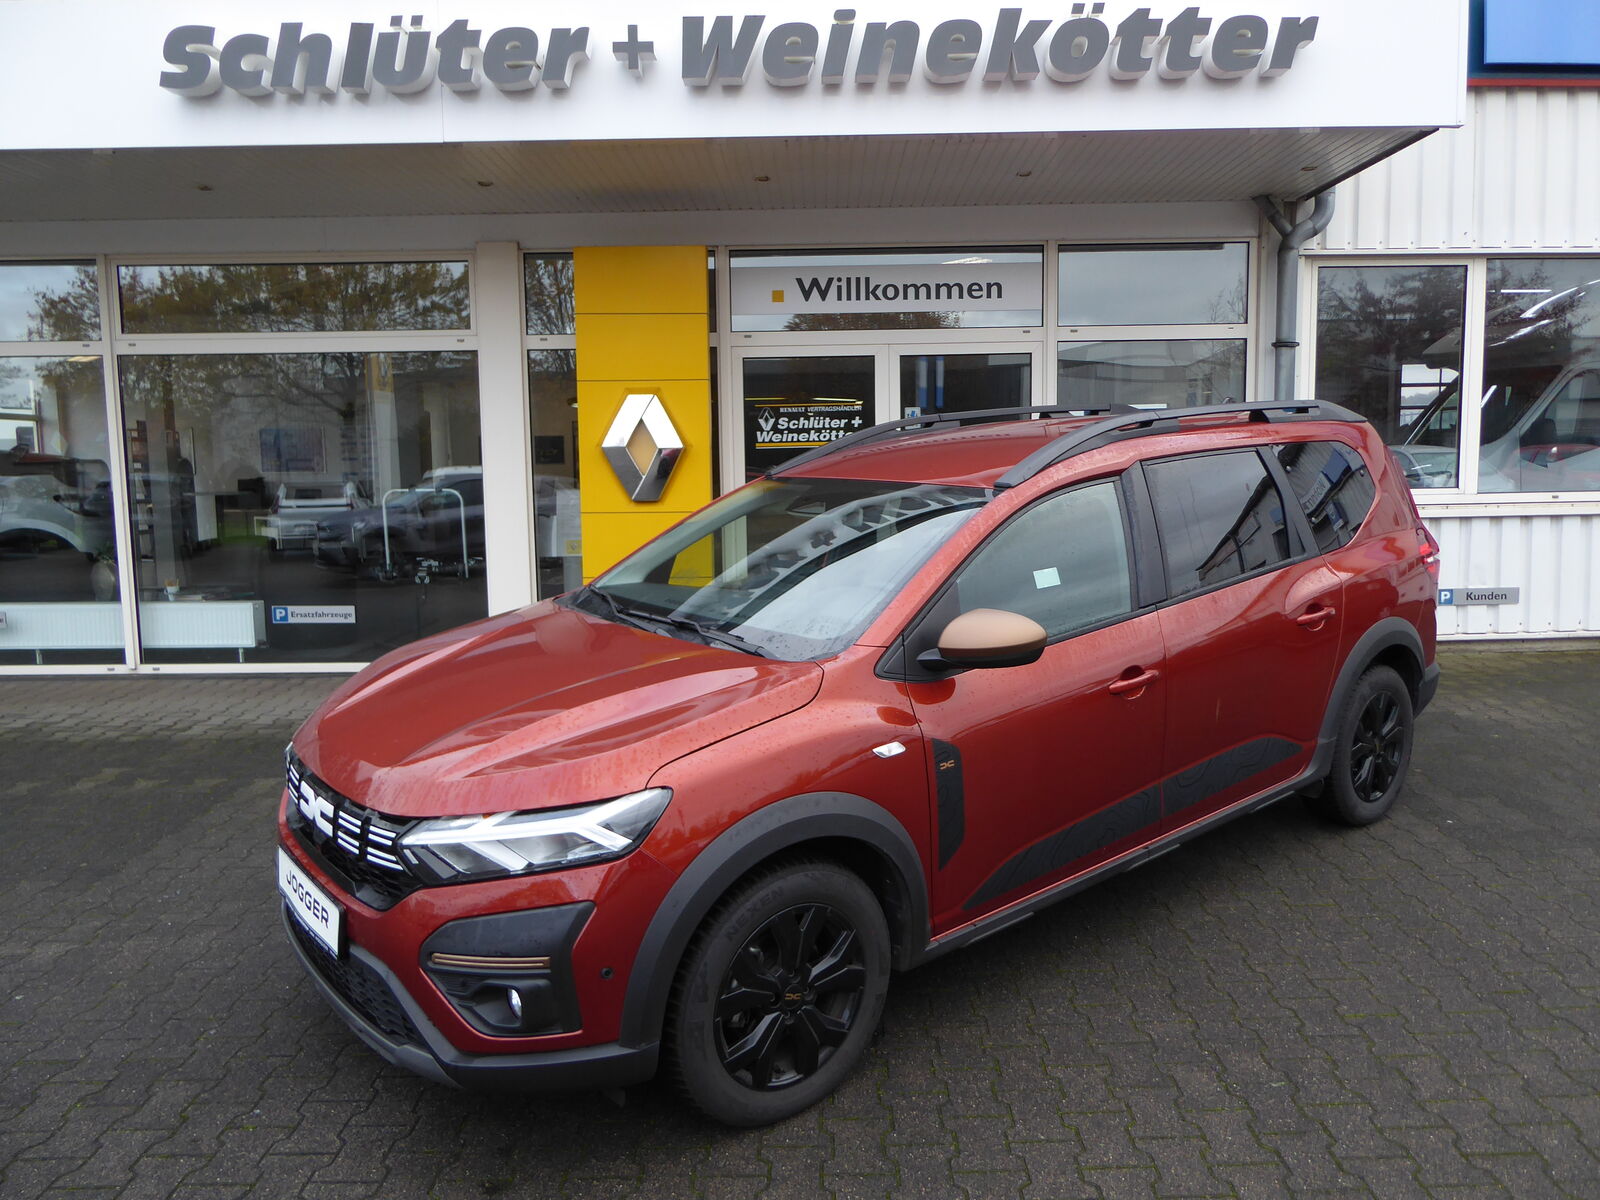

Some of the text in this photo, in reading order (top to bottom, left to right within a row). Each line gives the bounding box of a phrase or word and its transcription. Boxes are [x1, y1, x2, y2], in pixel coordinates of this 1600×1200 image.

[159, 3, 1319, 94] Schlüter + Weinekötter
[795, 276, 1003, 302] Willkommen
[777, 416, 863, 429] Schlüter +
[1440, 591, 1507, 603] P Kunden
[275, 608, 353, 620] P Ersatzfahrzeuge
[285, 869, 330, 929] JOGGER
[723, 886, 785, 942] NEXEN
